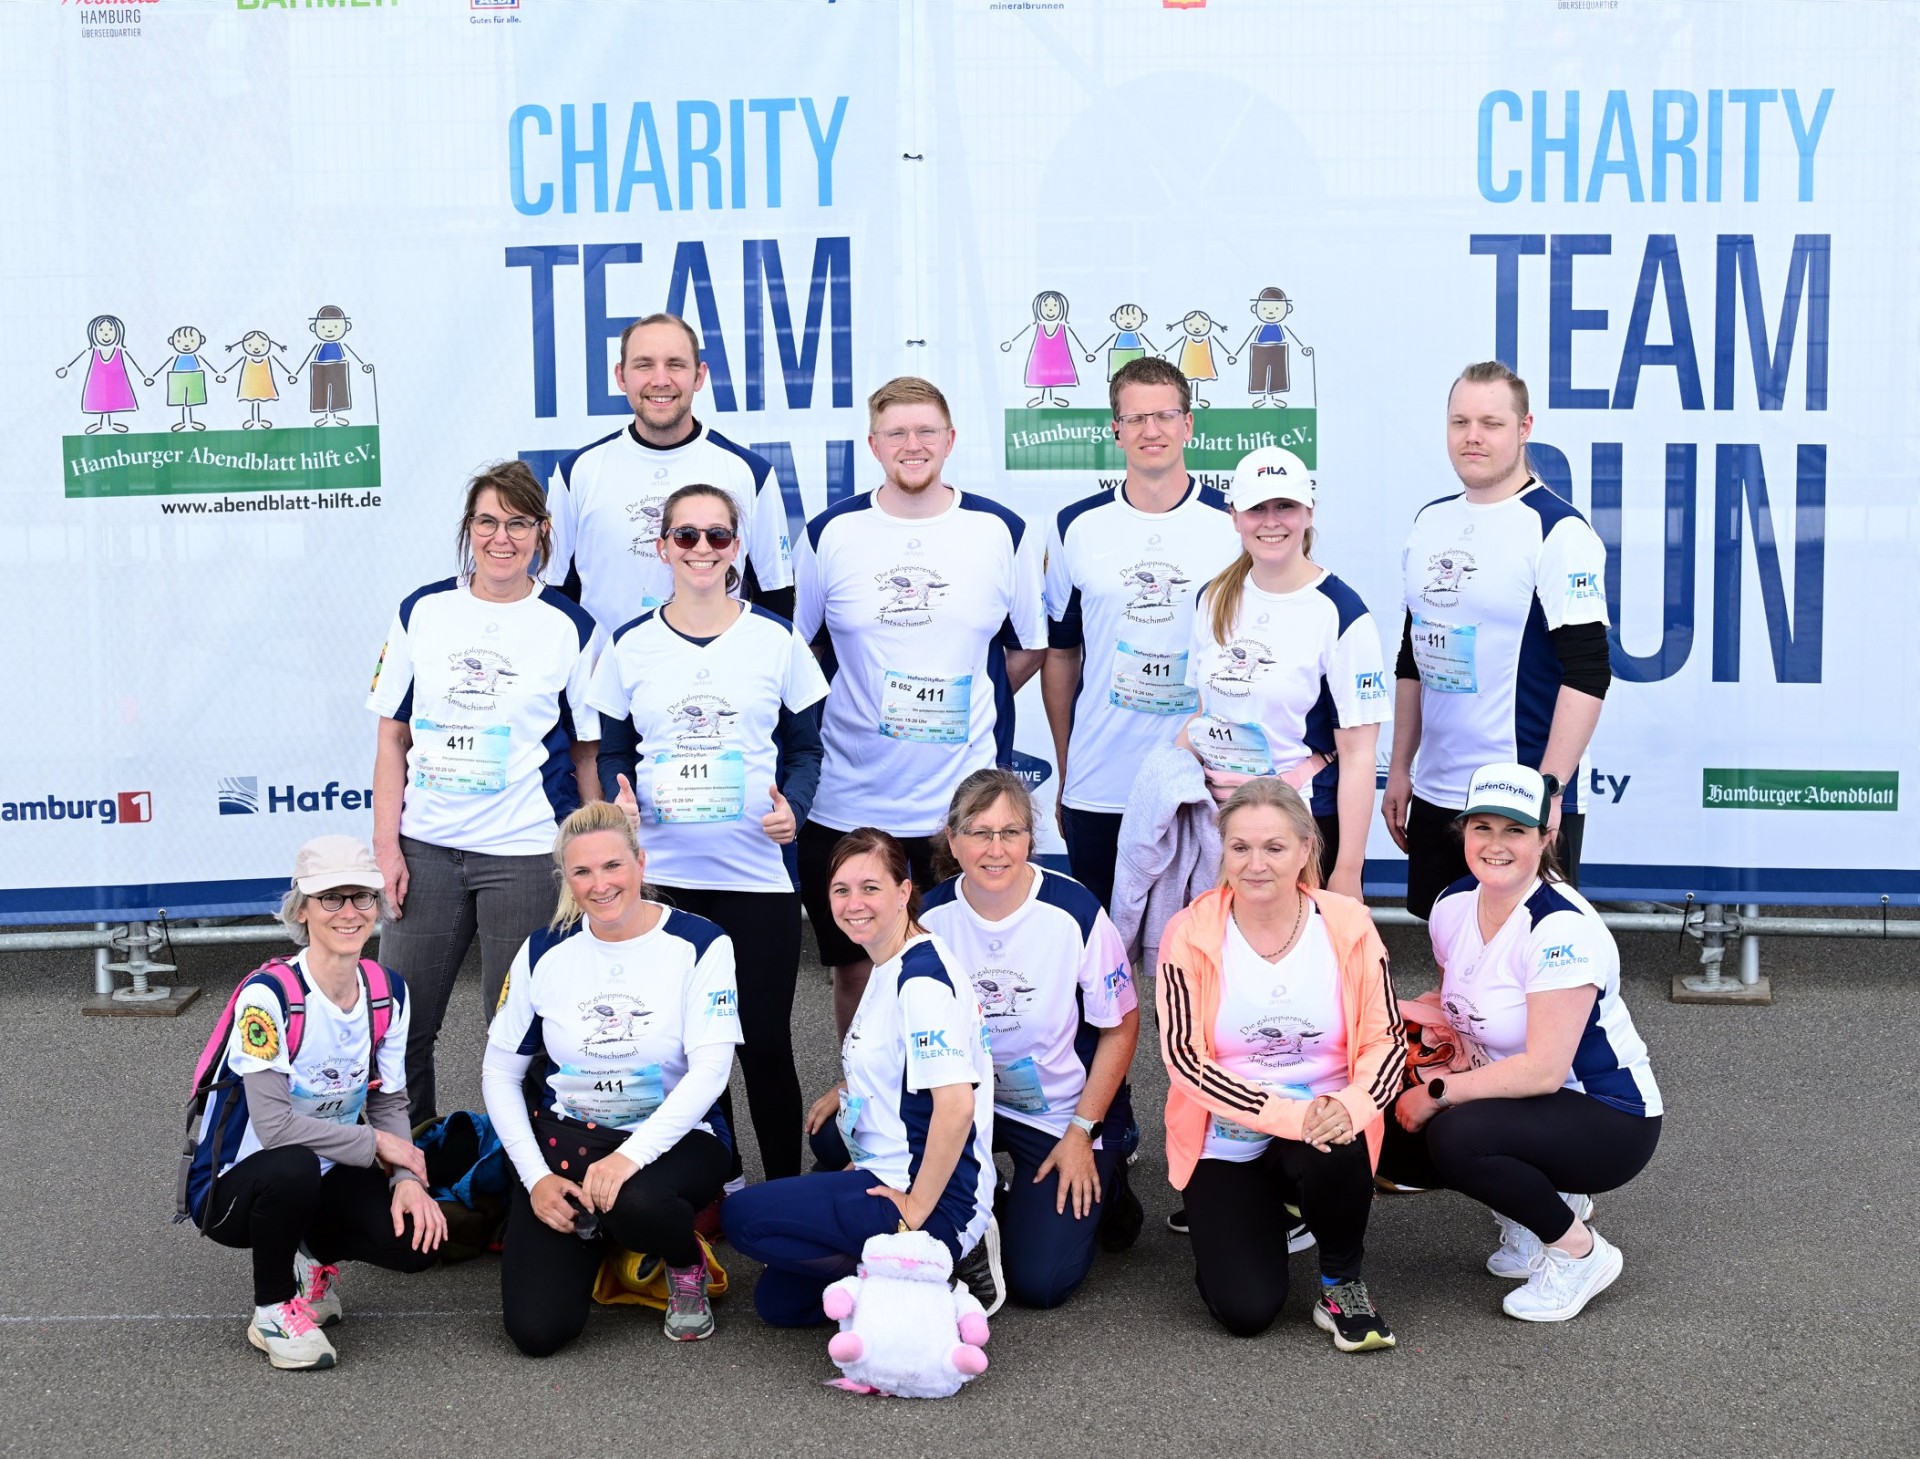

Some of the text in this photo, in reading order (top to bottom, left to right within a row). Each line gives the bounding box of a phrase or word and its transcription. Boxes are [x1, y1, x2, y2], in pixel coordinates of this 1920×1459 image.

[990, 2, 1064, 10] mineralbrunnen
[80, 9, 141, 25] HAMBURG
[470, 15, 521, 24] Gutes für alle.
[81, 28, 142, 38] ÜBERSEEQUARTIER
[1477, 88, 1835, 204] CHARITY
[508, 96, 850, 216] CHARITY
[505, 236, 853, 418] TEAM
[1470, 234, 1831, 411] TEAM
[1010, 423, 1114, 450] Hamburge
[1237, 431, 1277, 451] hilft
[1281, 426, 1313, 446] e.V.
[70, 443, 376, 477] Hamburger Abendblatt hilft e.V.
[1257, 466, 1287, 477] FILA
[161, 492, 381, 515] www.abendblatt-hilft.de
[874, 571, 889, 584] Die
[1119, 566, 1134, 578] Die
[873, 614, 934, 628] Amtsschimmel
[1121, 610, 1175, 624] Amtsschimmel
[1428, 633, 1446, 649] 411
[1142, 663, 1170, 677] 411
[908, 675, 945, 683] HafenCityRun
[898, 682, 912, 692] 652
[916, 687, 944, 702] 411
[666, 702, 680, 715] Die
[1209, 727, 1233, 742] 411
[447, 735, 475, 751] 411
[680, 763, 708, 779] 411
[1474, 782, 1536, 801] HafenCityRun
[1706, 783, 1894, 807] Hamburger Abendblatt
[0, 794, 117, 825] amburg
[1548, 957, 1589, 969] ELEKTRO
[577, 1000, 592, 1012] Die
[1239, 1015, 1316, 1036] Die galoppierenden
[577, 1046, 640, 1060] Amtsschimmel
[920, 1049, 965, 1062] ELEKTRO
[594, 1080, 623, 1094] 411
[316, 1100, 344, 1113] 411
